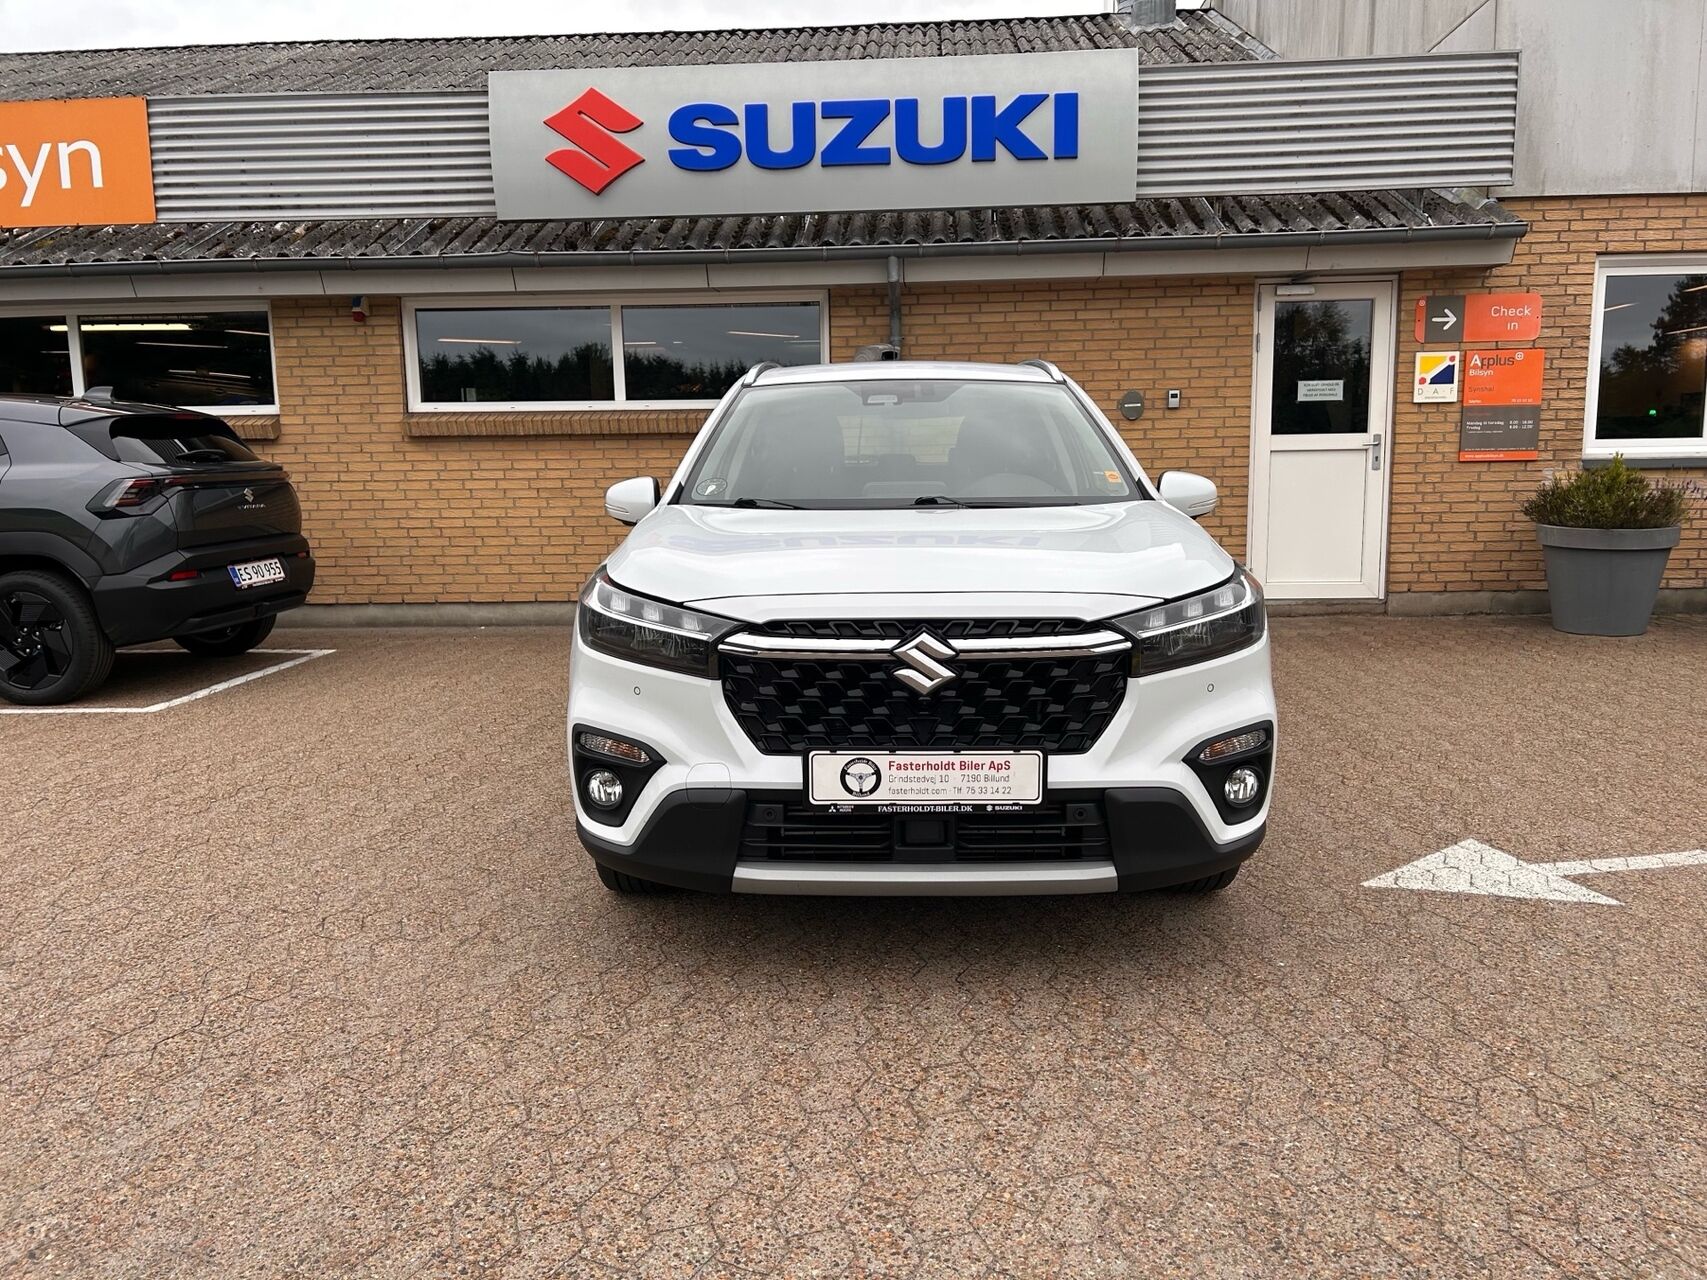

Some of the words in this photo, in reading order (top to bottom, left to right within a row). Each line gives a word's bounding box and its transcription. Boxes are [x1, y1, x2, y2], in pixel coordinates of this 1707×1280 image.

[667, 92, 1079, 172] SUZUKI
[1491, 305, 1532, 317] Check
[1507, 322, 1519, 331] in
[238, 566, 252, 581] ES
[252, 564, 264, 578] 90
[264, 561, 282, 577] 955
[888, 760, 956, 771] Fasterholdt
[959, 760, 986, 771] Biler
[989, 760, 1012, 773] ApS
[939, 774, 950, 783] 10
[960, 774, 982, 783] 7190
[984, 774, 1010, 783] Billund
[977, 786, 988, 795] 33
[990, 786, 1000, 795] 14
[1001, 786, 1012, 795] 22
[877, 805, 973, 813] FASTERHOLDT-BILER.DK
